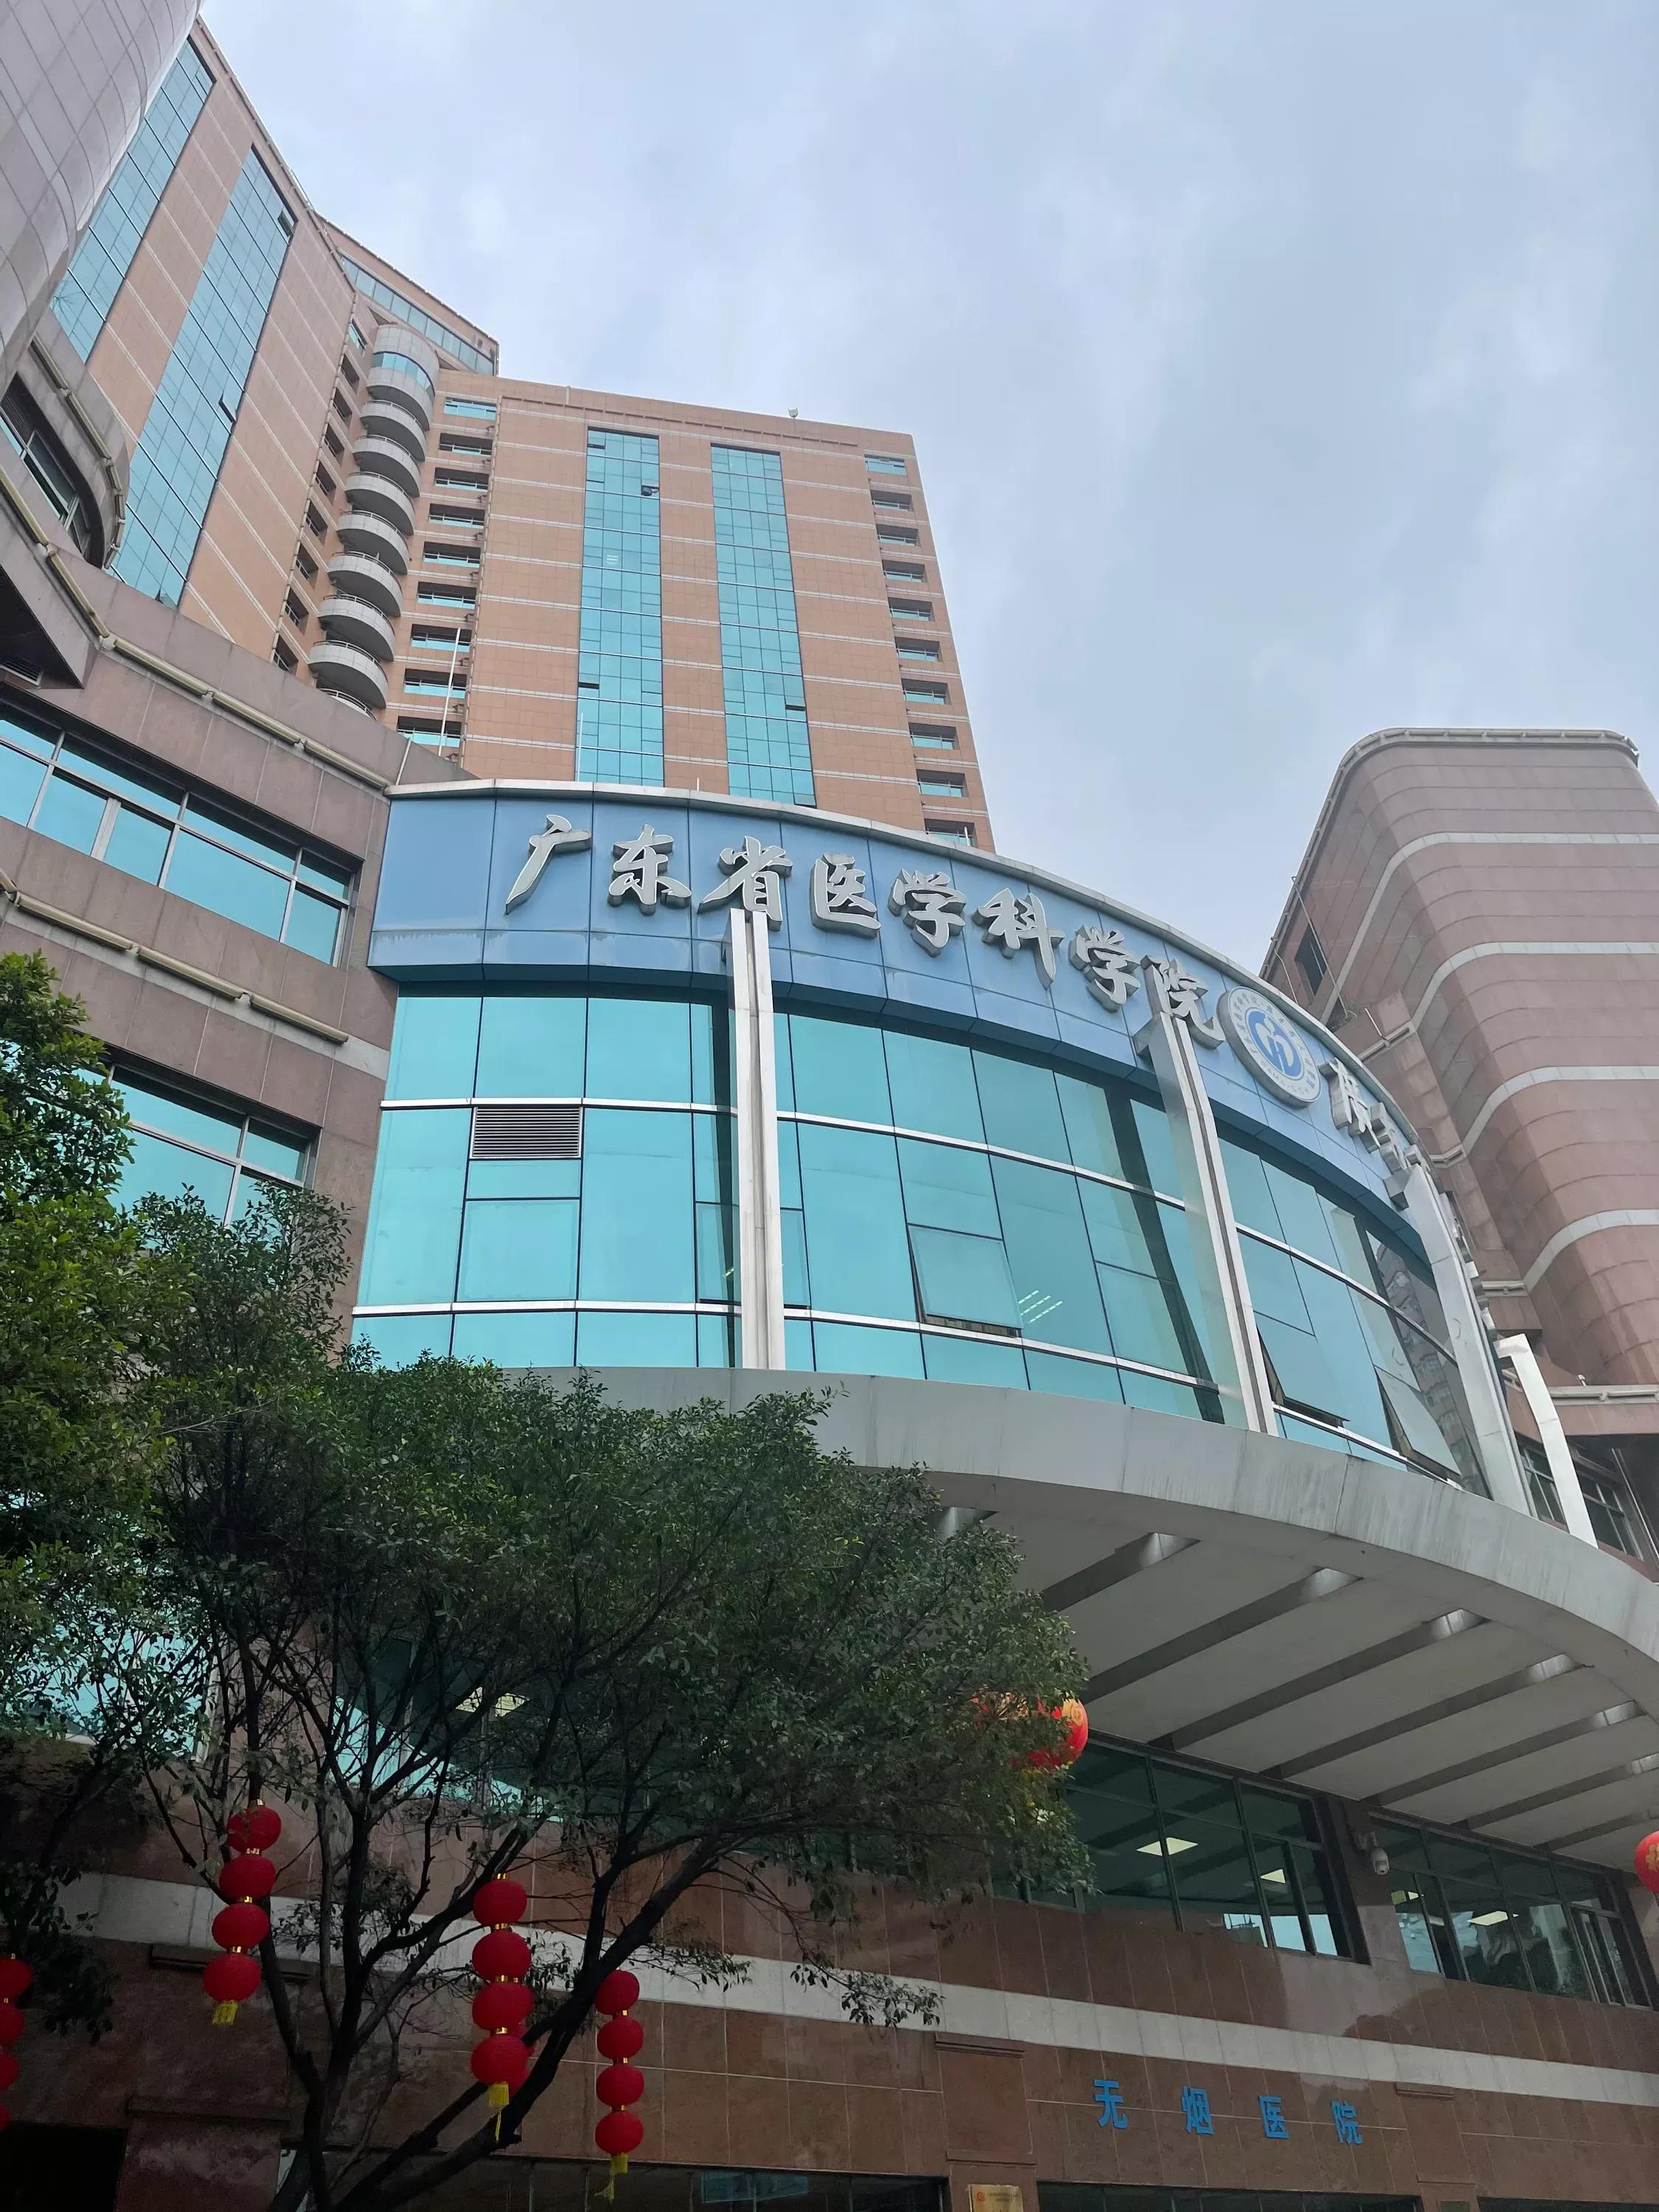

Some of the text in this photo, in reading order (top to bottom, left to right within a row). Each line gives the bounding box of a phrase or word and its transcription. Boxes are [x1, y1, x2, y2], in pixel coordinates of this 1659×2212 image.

[505, 814, 1226, 1050] 广东省医学科学院
[1093, 2079, 1363, 2145] 无烟医院
